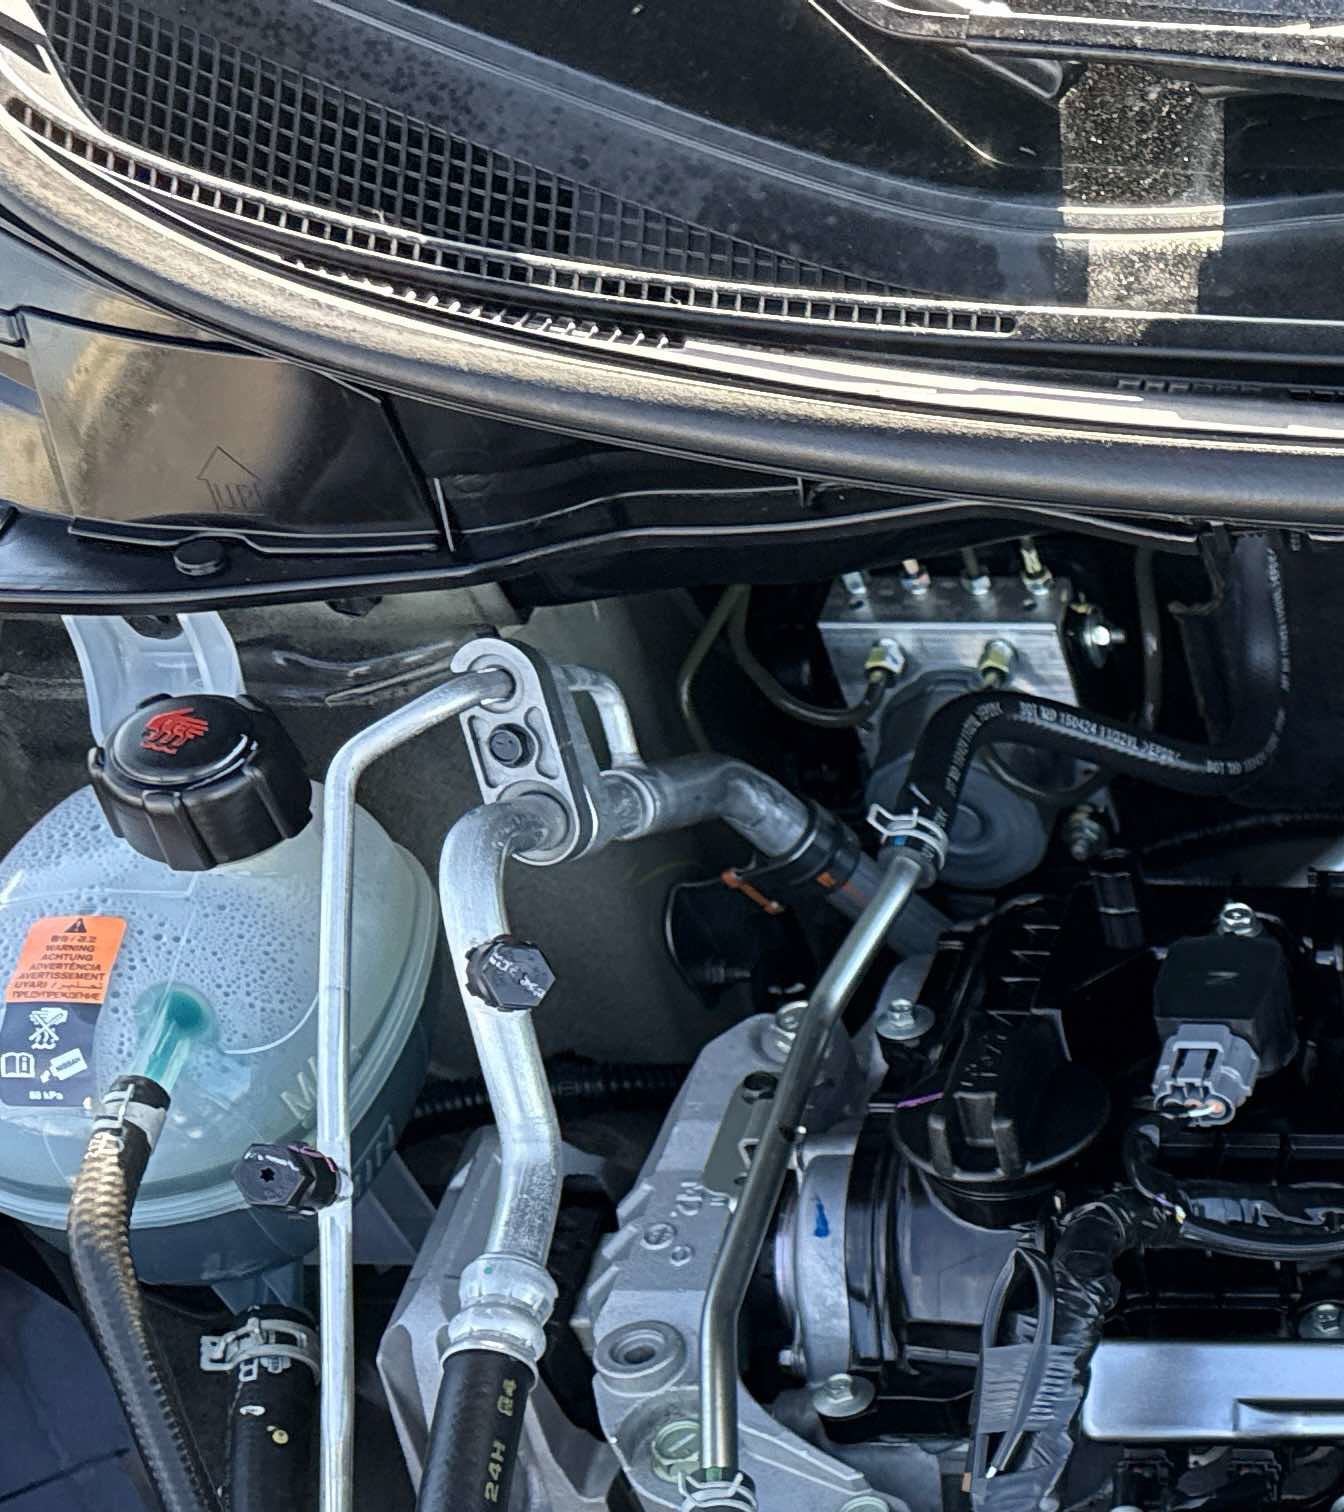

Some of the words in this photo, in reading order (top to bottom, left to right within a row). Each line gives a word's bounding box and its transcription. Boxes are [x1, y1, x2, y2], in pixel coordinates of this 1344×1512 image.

[45, 944, 96, 953] WARNING
[40, 953, 94, 961] ACHTUNG
[17, 972, 106, 981] AVERTISSEMENT
[484, 1440, 506, 1502] 24H
